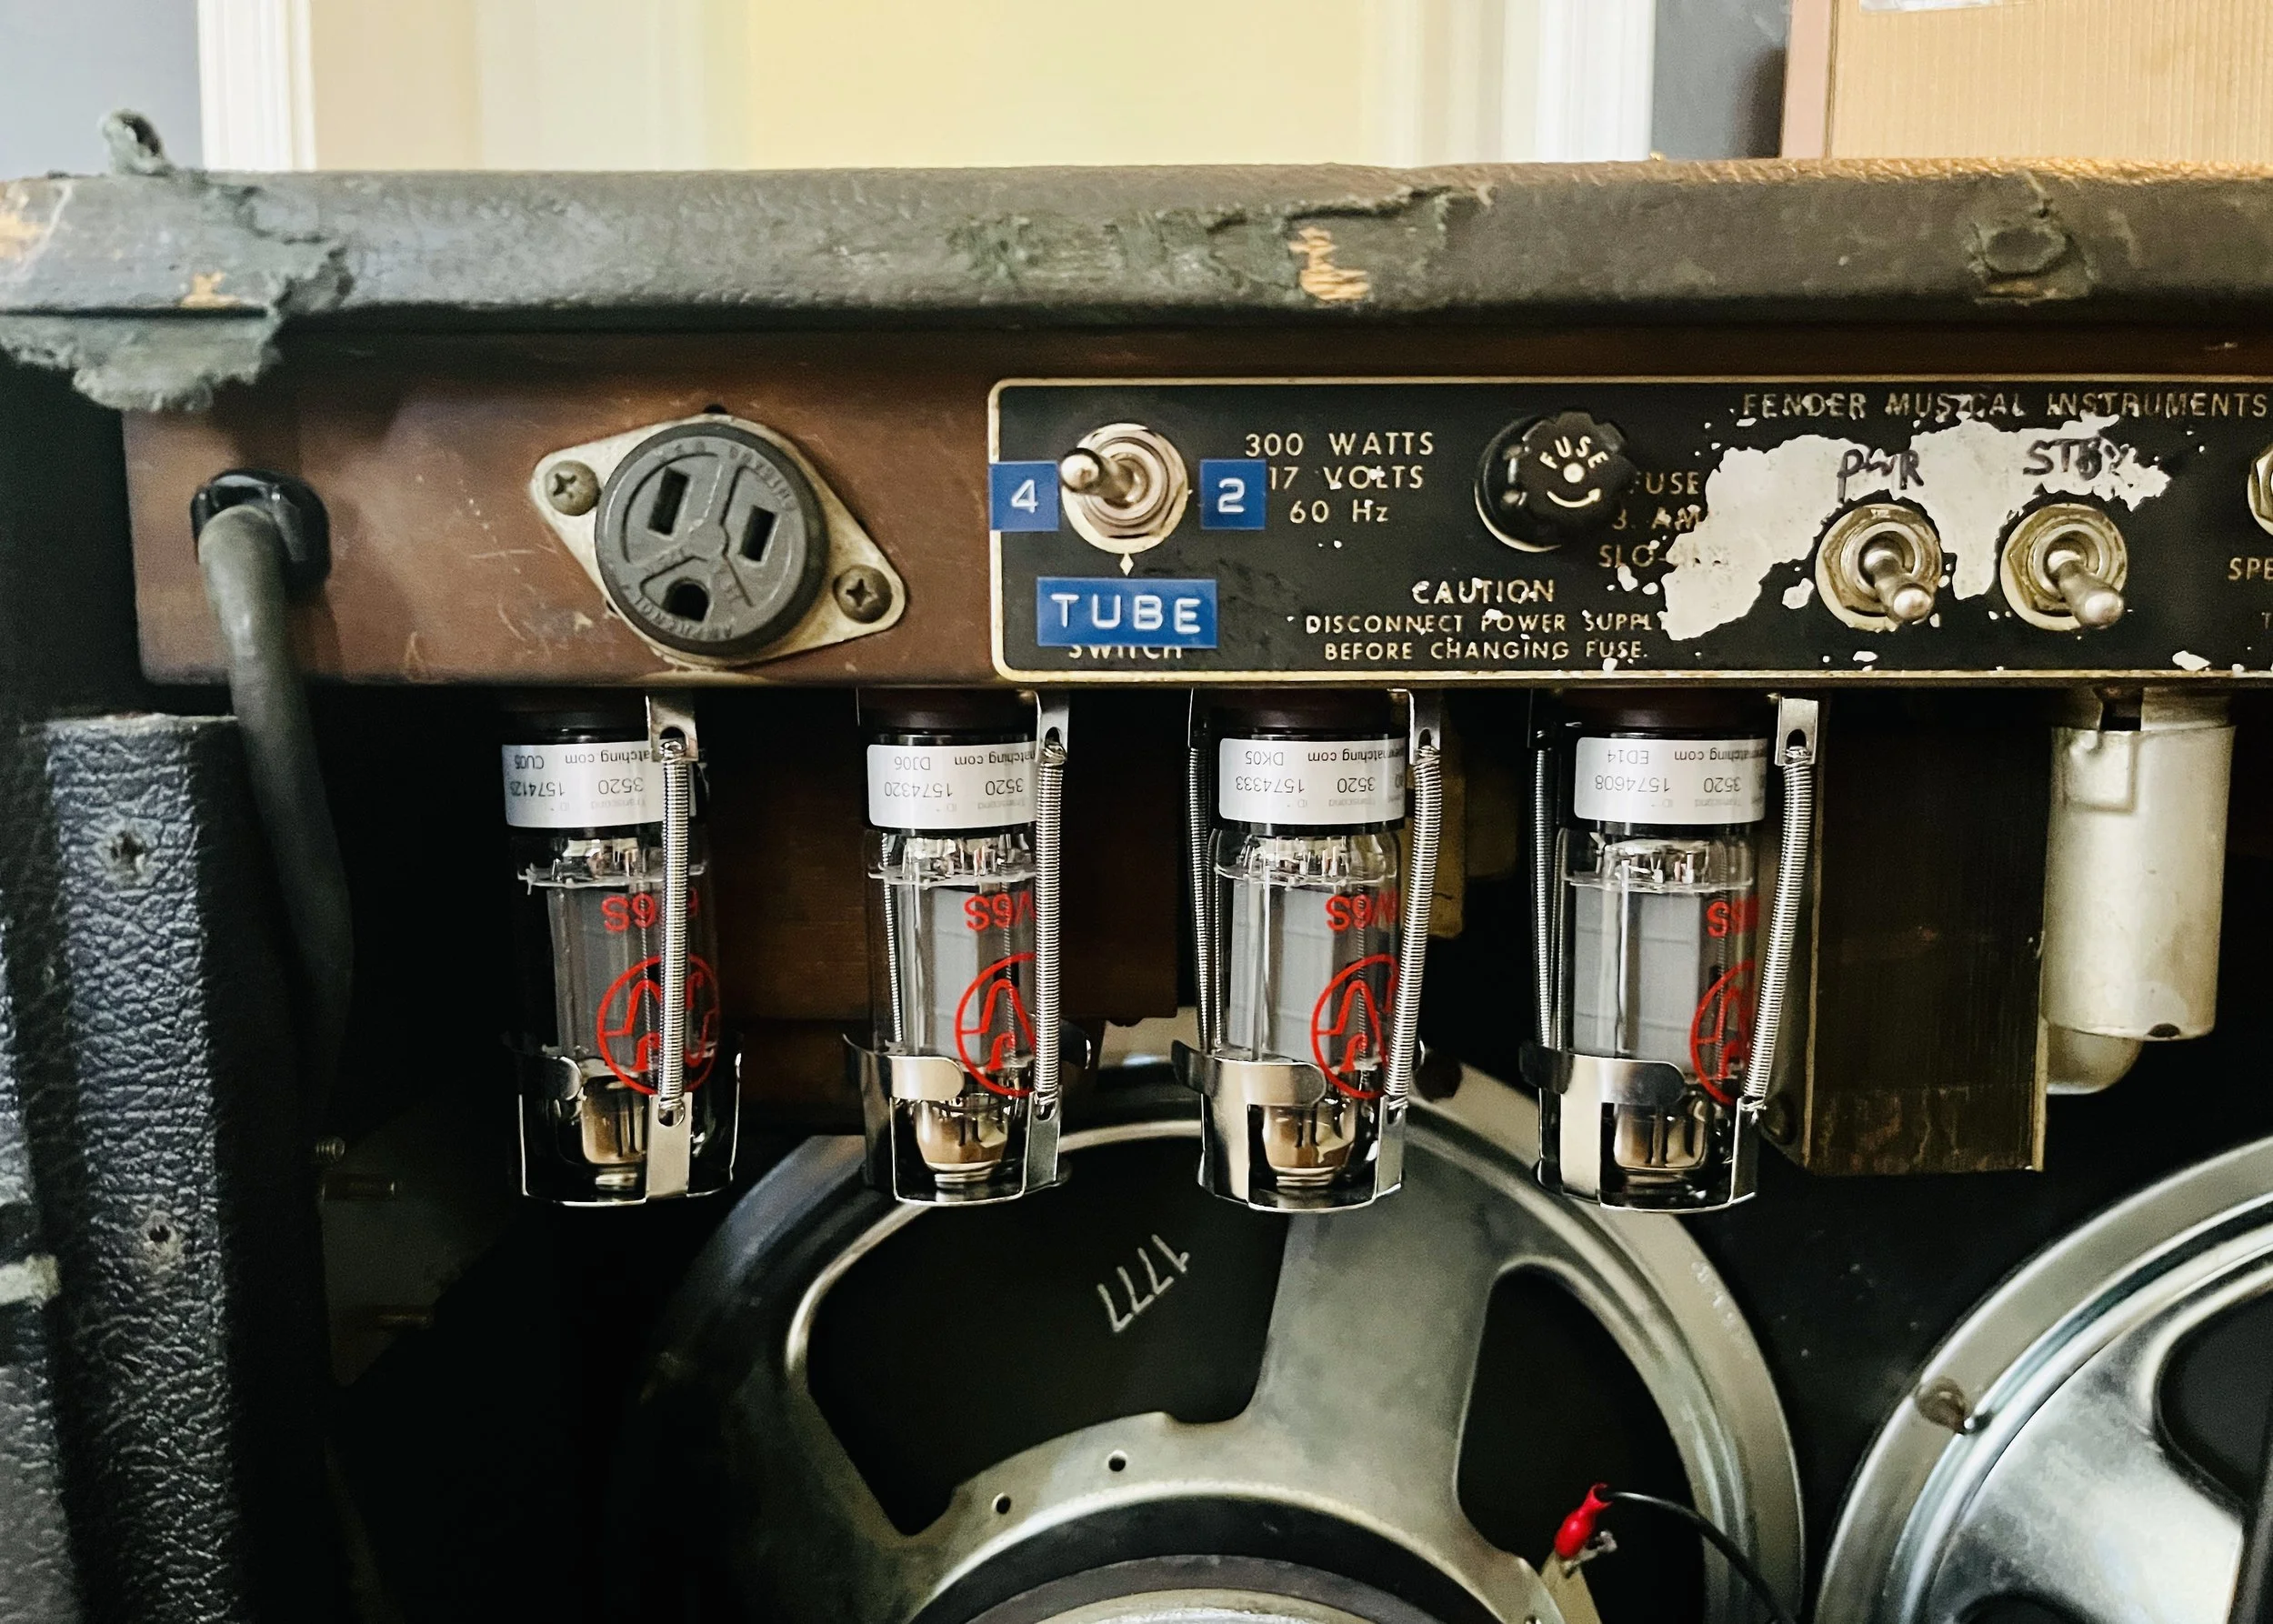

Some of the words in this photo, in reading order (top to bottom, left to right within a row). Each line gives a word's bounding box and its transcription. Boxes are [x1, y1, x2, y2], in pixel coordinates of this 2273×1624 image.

[1743, 392, 1867, 420] FENDER
[1885, 392, 2026, 422] MUSICAL
[2047, 391, 2268, 418] INSTRUMENTS
[1245, 432, 1304, 457] 300
[1327, 431, 1434, 456] WATTS
[1538, 435, 1609, 470] FUSE
[1322, 465, 1424, 490] VOLTS
[1636, 471, 1700, 495] USE
[1010, 478, 1039, 515] 4
[1217, 476, 1247, 514] 2
[1289, 500, 1330, 524] 60
[1351, 498, 1389, 523] Hz
[1411, 577, 1555, 604] CAUTION
[1050, 593, 1202, 636] TUBE
[1306, 614, 1464, 636] DISCONNECT
[1480, 609, 1567, 633] POWER
[1324, 641, 1414, 661] BEFORE
[1429, 637, 1570, 661] CHANGING
[1244, 750, 1285, 767] DK05
[1607, 749, 1650, 766] ED14
[597, 776, 645, 796] 3520
[884, 780, 954, 798] 1574320
[985, 777, 1025, 797] 3520
[1235, 775, 1306, 794] 1574333
[1337, 776, 1377, 794] 3520
[1595, 774, 1671, 793] 1574608
[1703, 776, 1742, 794] 3520
